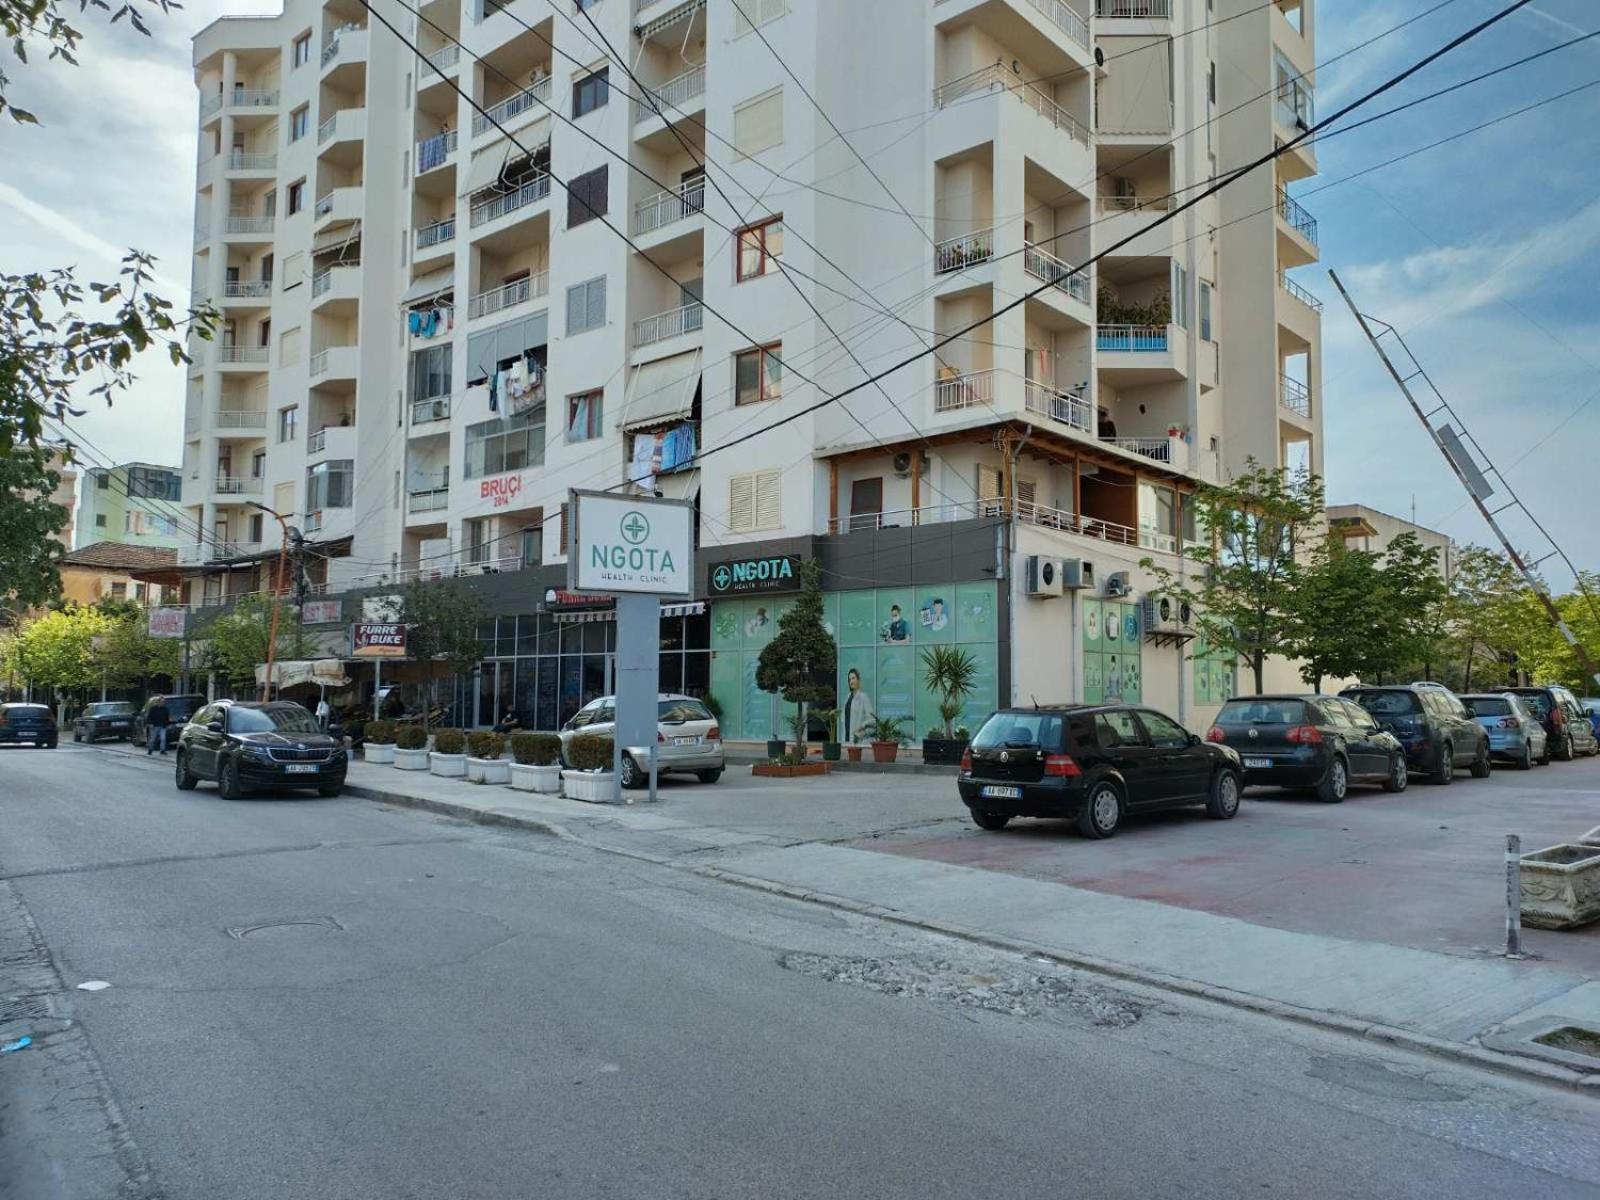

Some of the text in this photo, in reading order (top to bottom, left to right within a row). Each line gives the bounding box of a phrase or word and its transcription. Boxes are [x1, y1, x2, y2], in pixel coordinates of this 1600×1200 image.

[481, 475, 522, 498] BRUÇI
[493, 495, 509, 507] 2014
[592, 544, 676, 573] NGOTA
[601, 572, 668, 583] HEALTH CLINIC
[732, 558, 793, 582] NGOTA
[370, 635, 403, 644] BUKE
